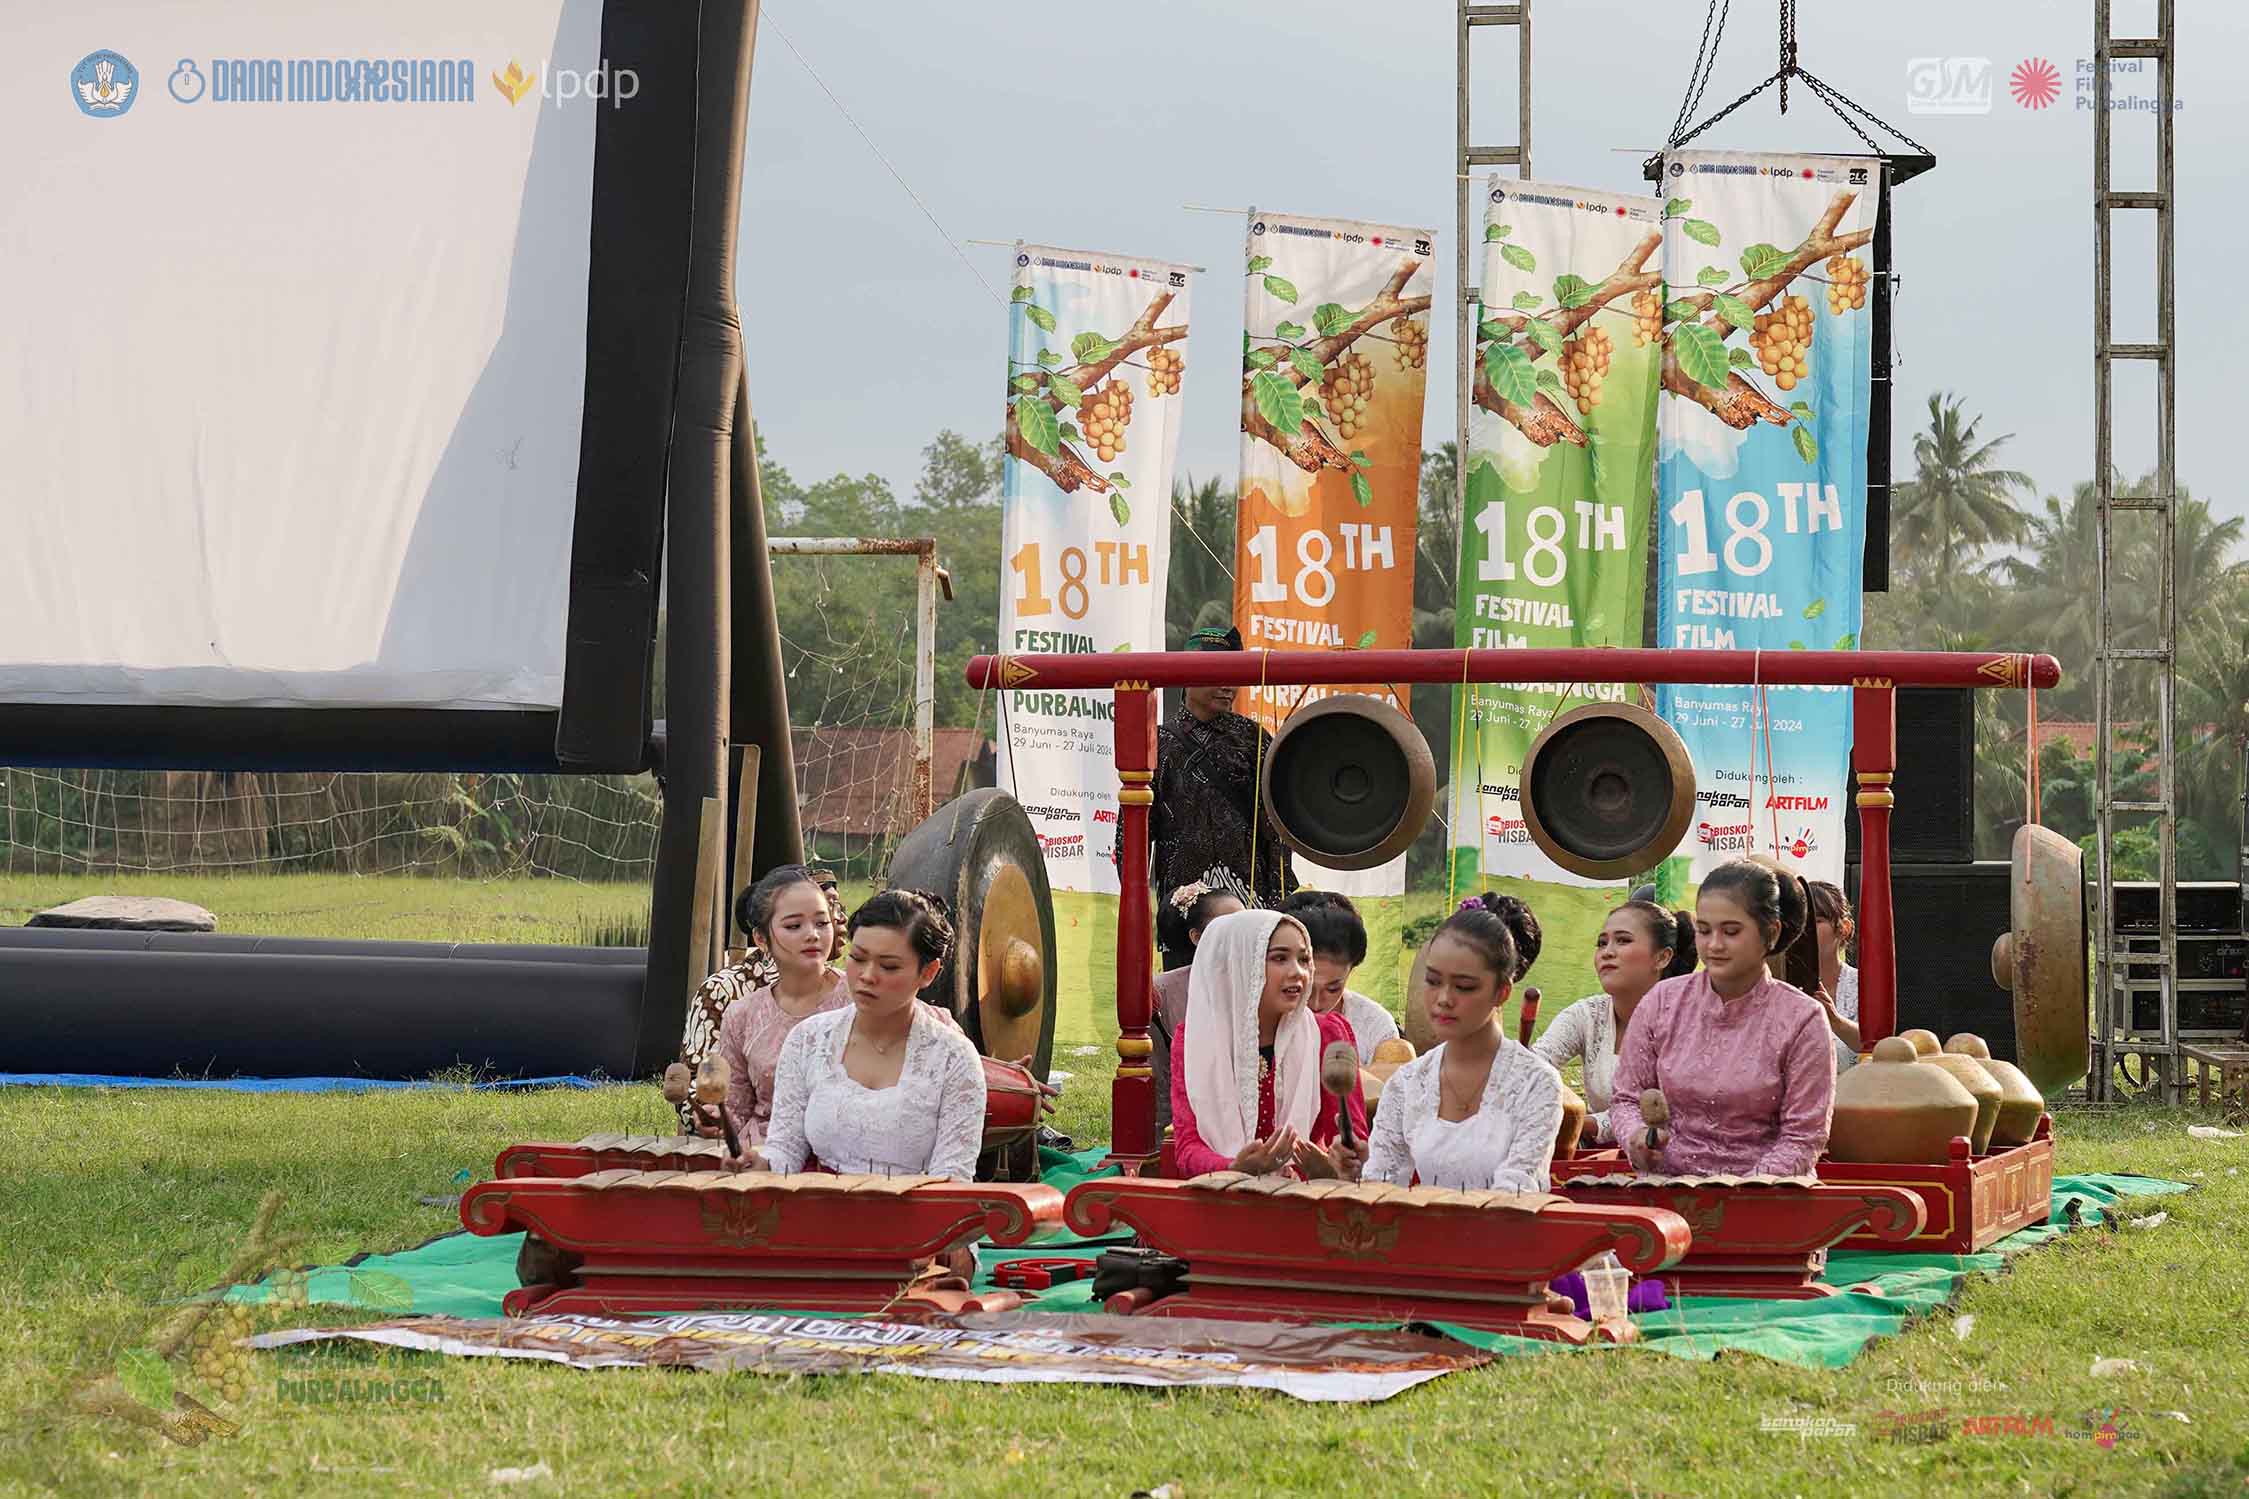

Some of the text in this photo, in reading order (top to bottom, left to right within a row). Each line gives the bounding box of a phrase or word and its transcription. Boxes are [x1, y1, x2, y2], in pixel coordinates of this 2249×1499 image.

[1770, 168, 1793, 178] lpdp
[1585, 201, 1608, 214] lpdp
[1343, 232, 1364, 243] lpdp
[1102, 265, 1122, 276] lpdp
[1670, 482, 1843, 577] 18TH
[1473, 500, 1626, 587] 18TH
[1247, 522, 1395, 608] 18TH
[1009, 541, 1150, 620] 18TH
[1475, 593, 1574, 628] FESTIVAL
[1676, 588, 1784, 619] FESTIVAL
[1250, 614, 1345, 647] FESTIVAL
[1473, 627, 1528, 649] FILM
[1676, 624, 1736, 650] FILM
[1015, 629, 1097, 654] FESTIVAL
[1471, 694, 1554, 719] Banyumas Raya
[1675, 696, 1738, 713] Banyumas
[1486, 711, 1511, 725] Juni
[1520, 718, 1530, 729] 27
[1675, 712, 1688, 723] 29
[1692, 714, 1719, 727] Juni
[1731, 717, 1744, 729] 27
[1773, 719, 1803, 731] 2024
[1014, 723, 1095, 740] Banyumas Raya
[1013, 737, 1026, 748] 29
[1030, 740, 1052, 750] Juni
[1063, 741, 1075, 751] 27
[1078, 742, 1095, 753] Juli
[1772, 775, 1795, 784] oleh
[1050, 787, 1095, 800] Didukung
[1697, 790, 1737, 801] ngkan
[1710, 799, 1750, 809] paran
[1765, 795, 1828, 810] ARTFILM
[1045, 813, 1081, 821] paran
[1049, 834, 1084, 846] BIOSKOP
